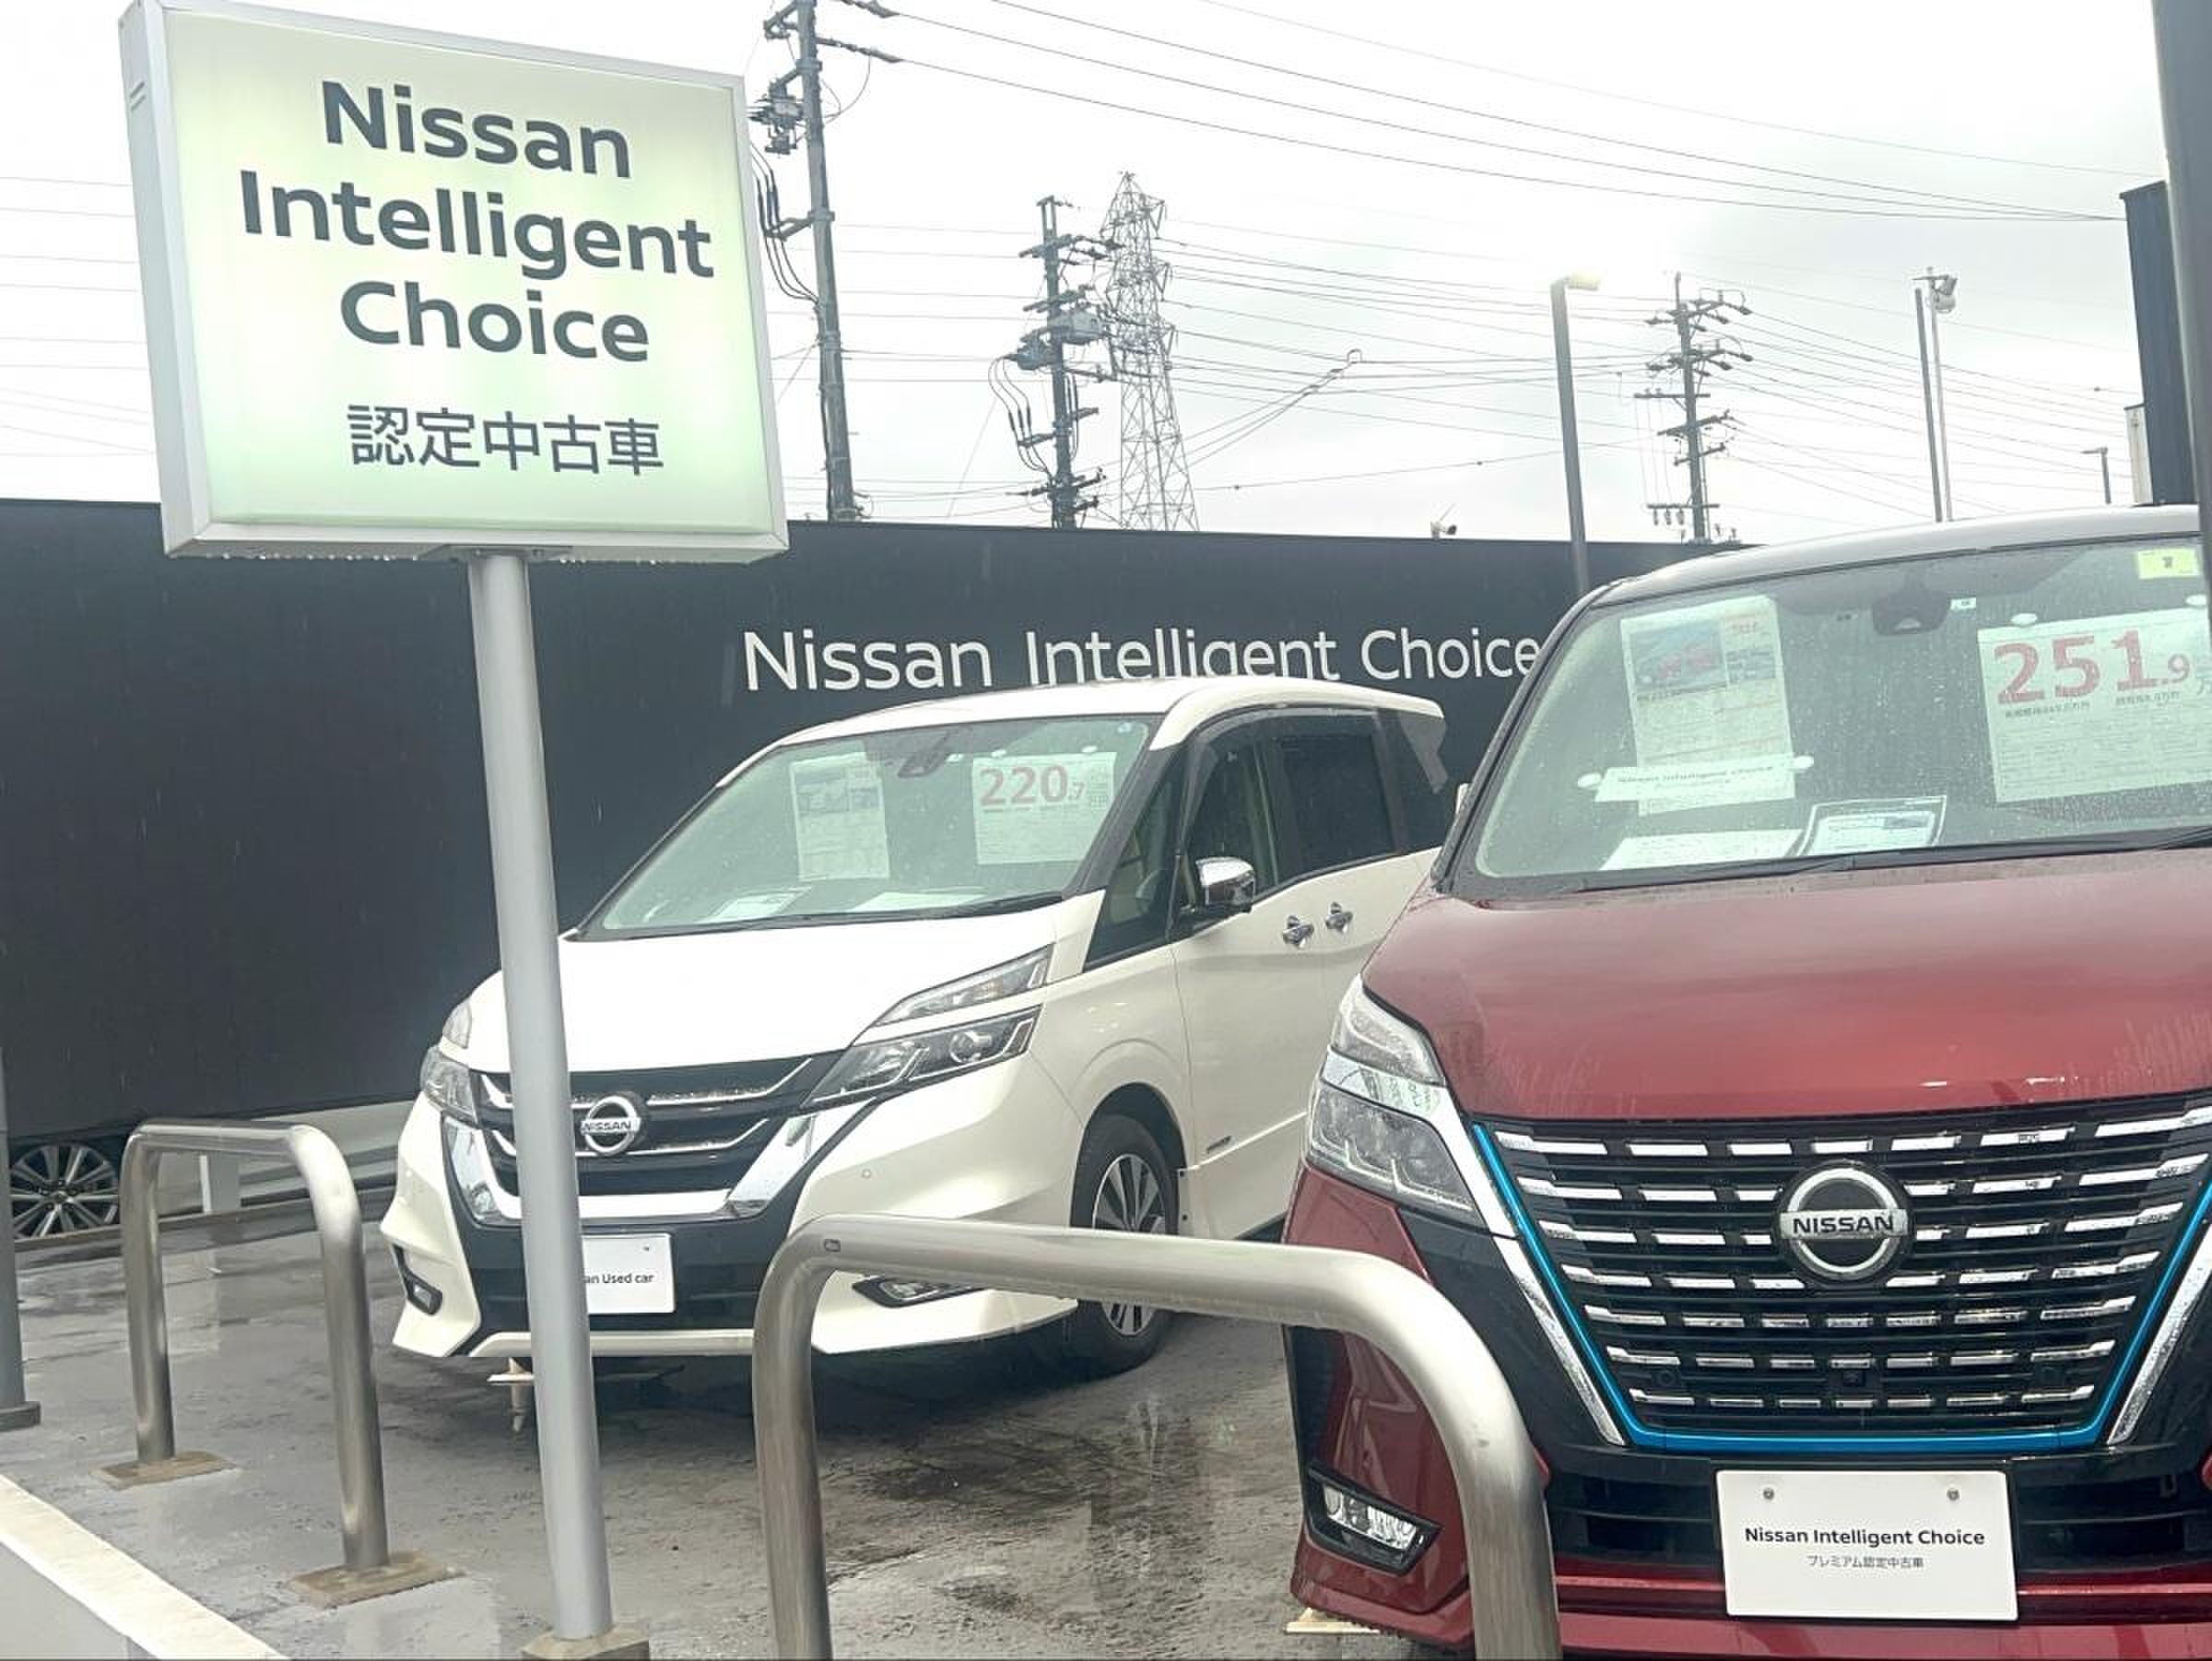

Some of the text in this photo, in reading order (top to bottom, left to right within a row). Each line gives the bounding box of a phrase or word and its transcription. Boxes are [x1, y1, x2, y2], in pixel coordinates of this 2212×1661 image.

[322, 80, 631, 179] Nissan
[239, 170, 714, 280] Intelligent
[339, 280, 649, 362] Choice
[347, 404, 664, 476] 認定中古車
[744, 627, 1541, 690] Nissan Intelligent Choice
[1793, 1215, 1894, 1233] NISSAN
[602, 1273, 632, 1284] Used
[634, 1275, 654, 1284] car
[1745, 1526, 1985, 1548] Nissan Intelligent Choice
